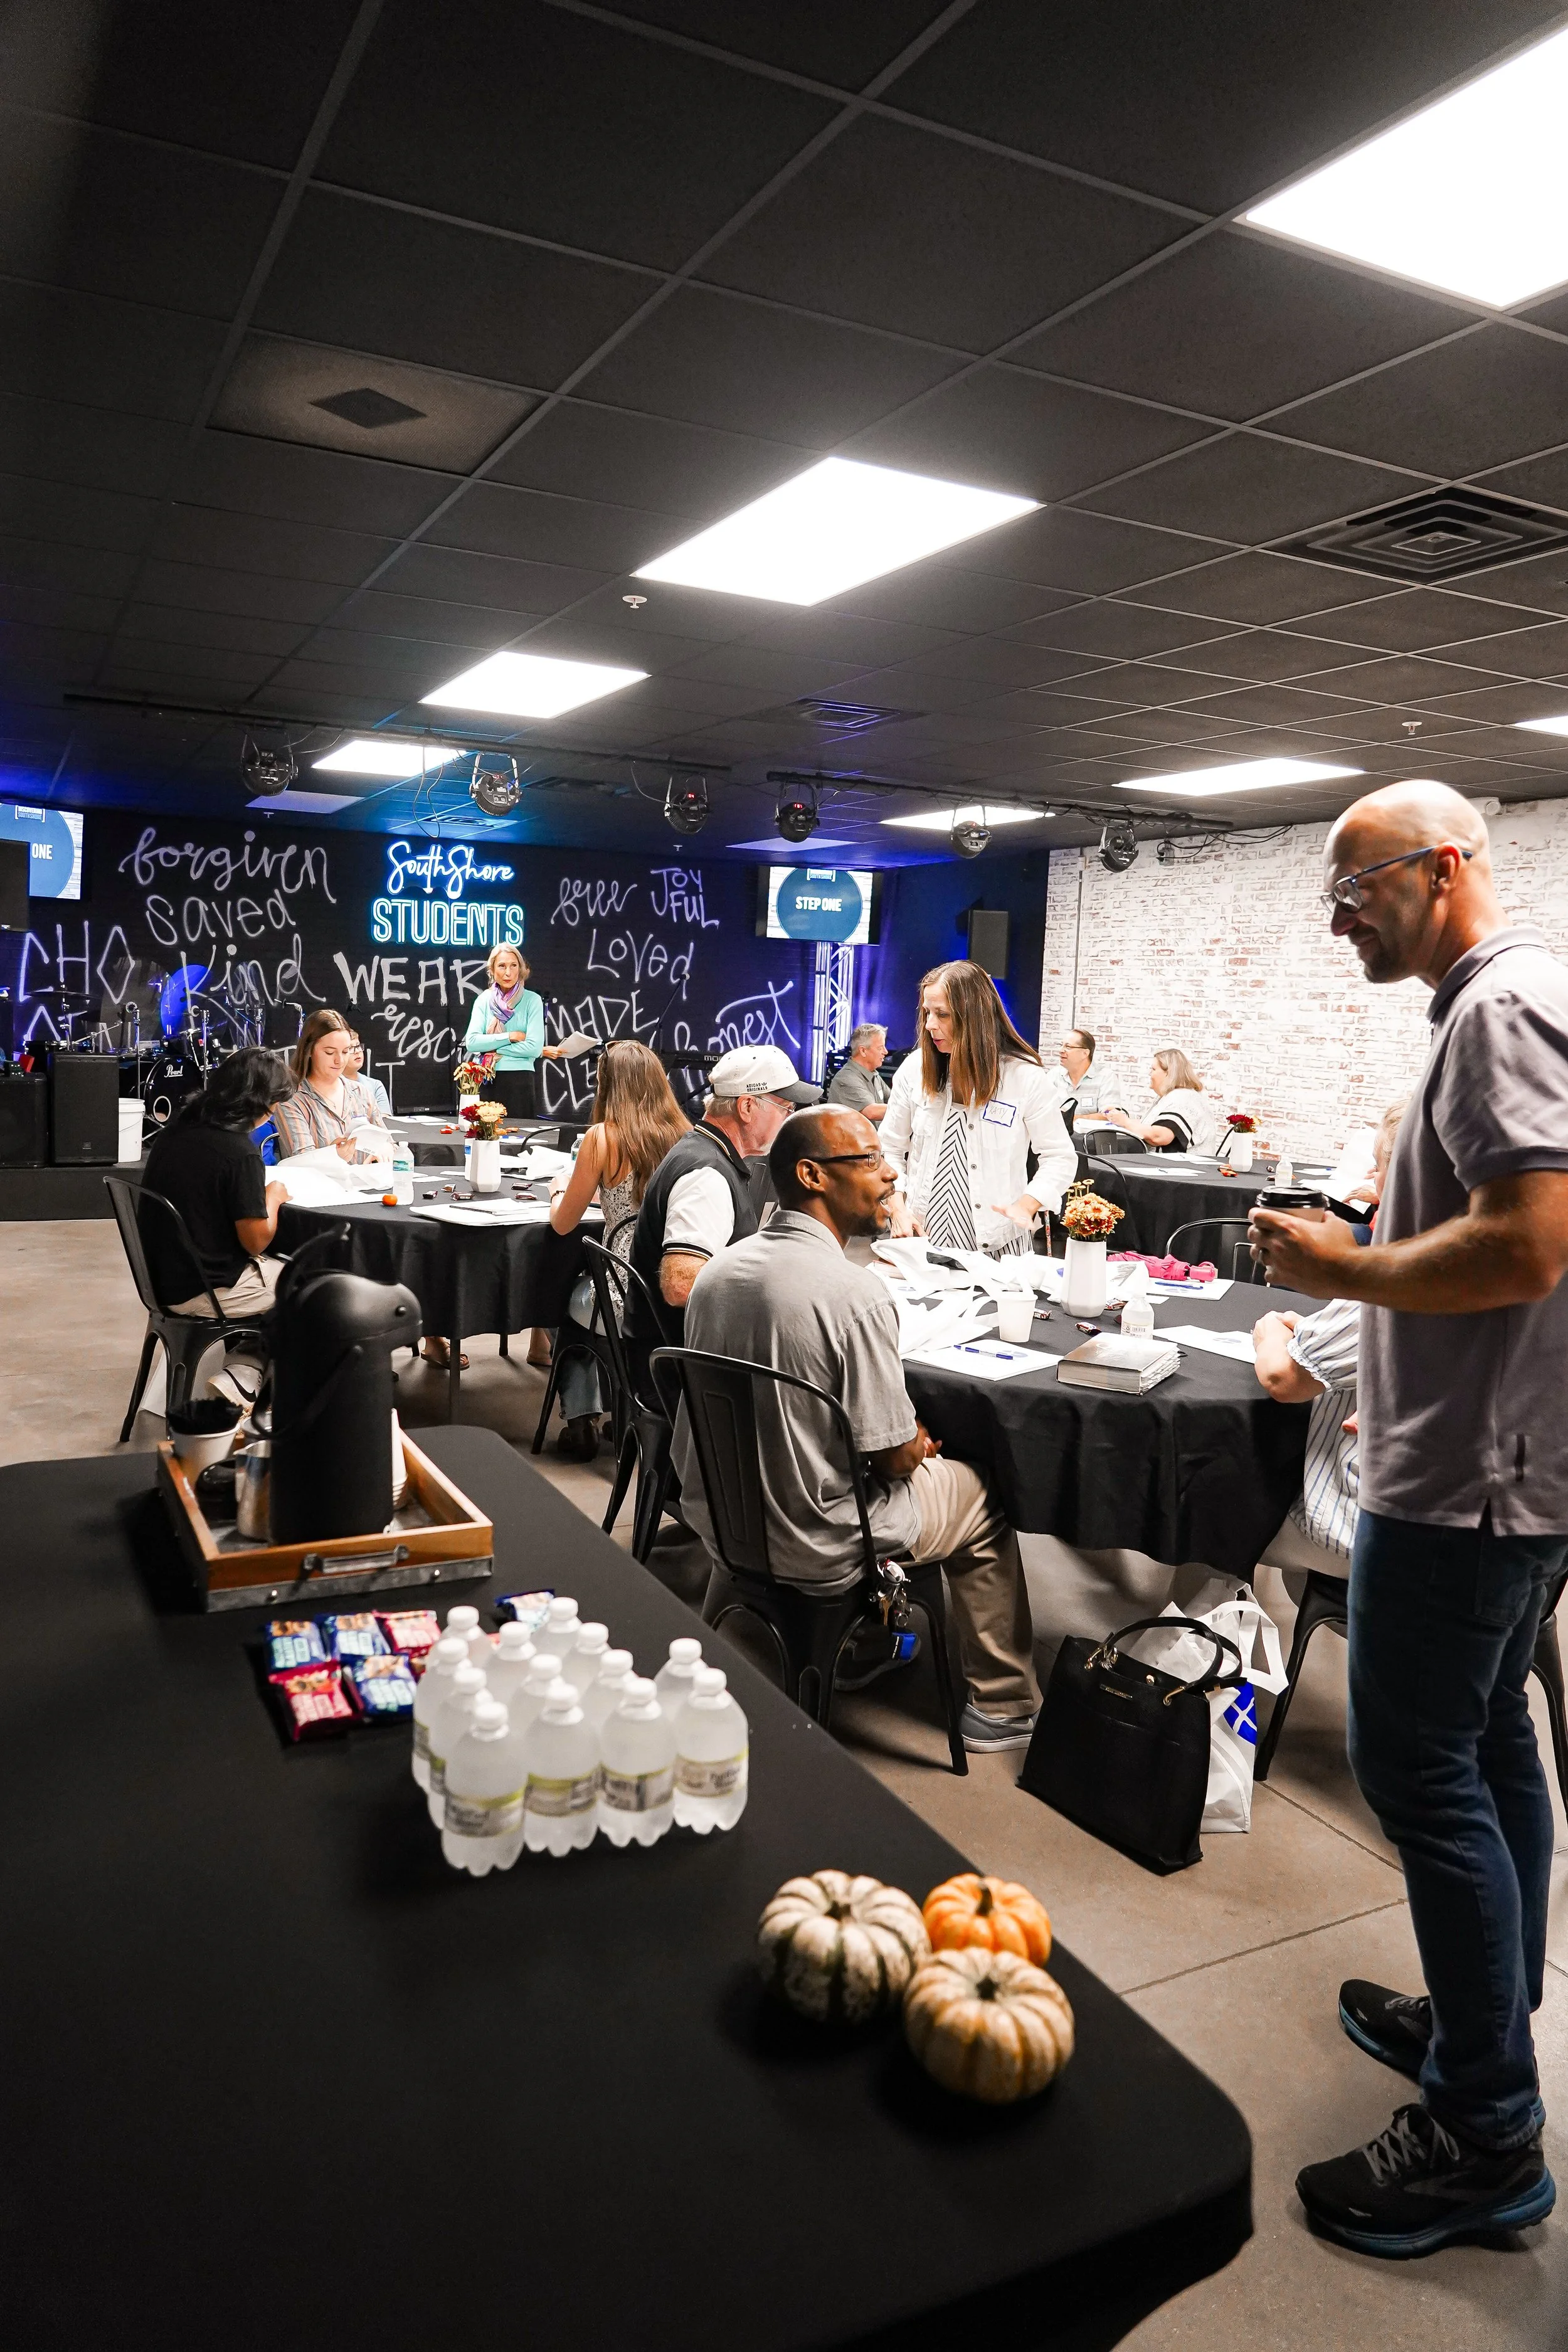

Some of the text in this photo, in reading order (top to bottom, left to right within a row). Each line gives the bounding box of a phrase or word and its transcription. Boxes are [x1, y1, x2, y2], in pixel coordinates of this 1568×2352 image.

[32, 843, 53, 860] ONE
[119, 827, 337, 903] forgiven
[795, 896, 842, 912] STEP ONE
[373, 898, 524, 947] STUDENTS
[164, 1064, 183, 1078] Pearl
